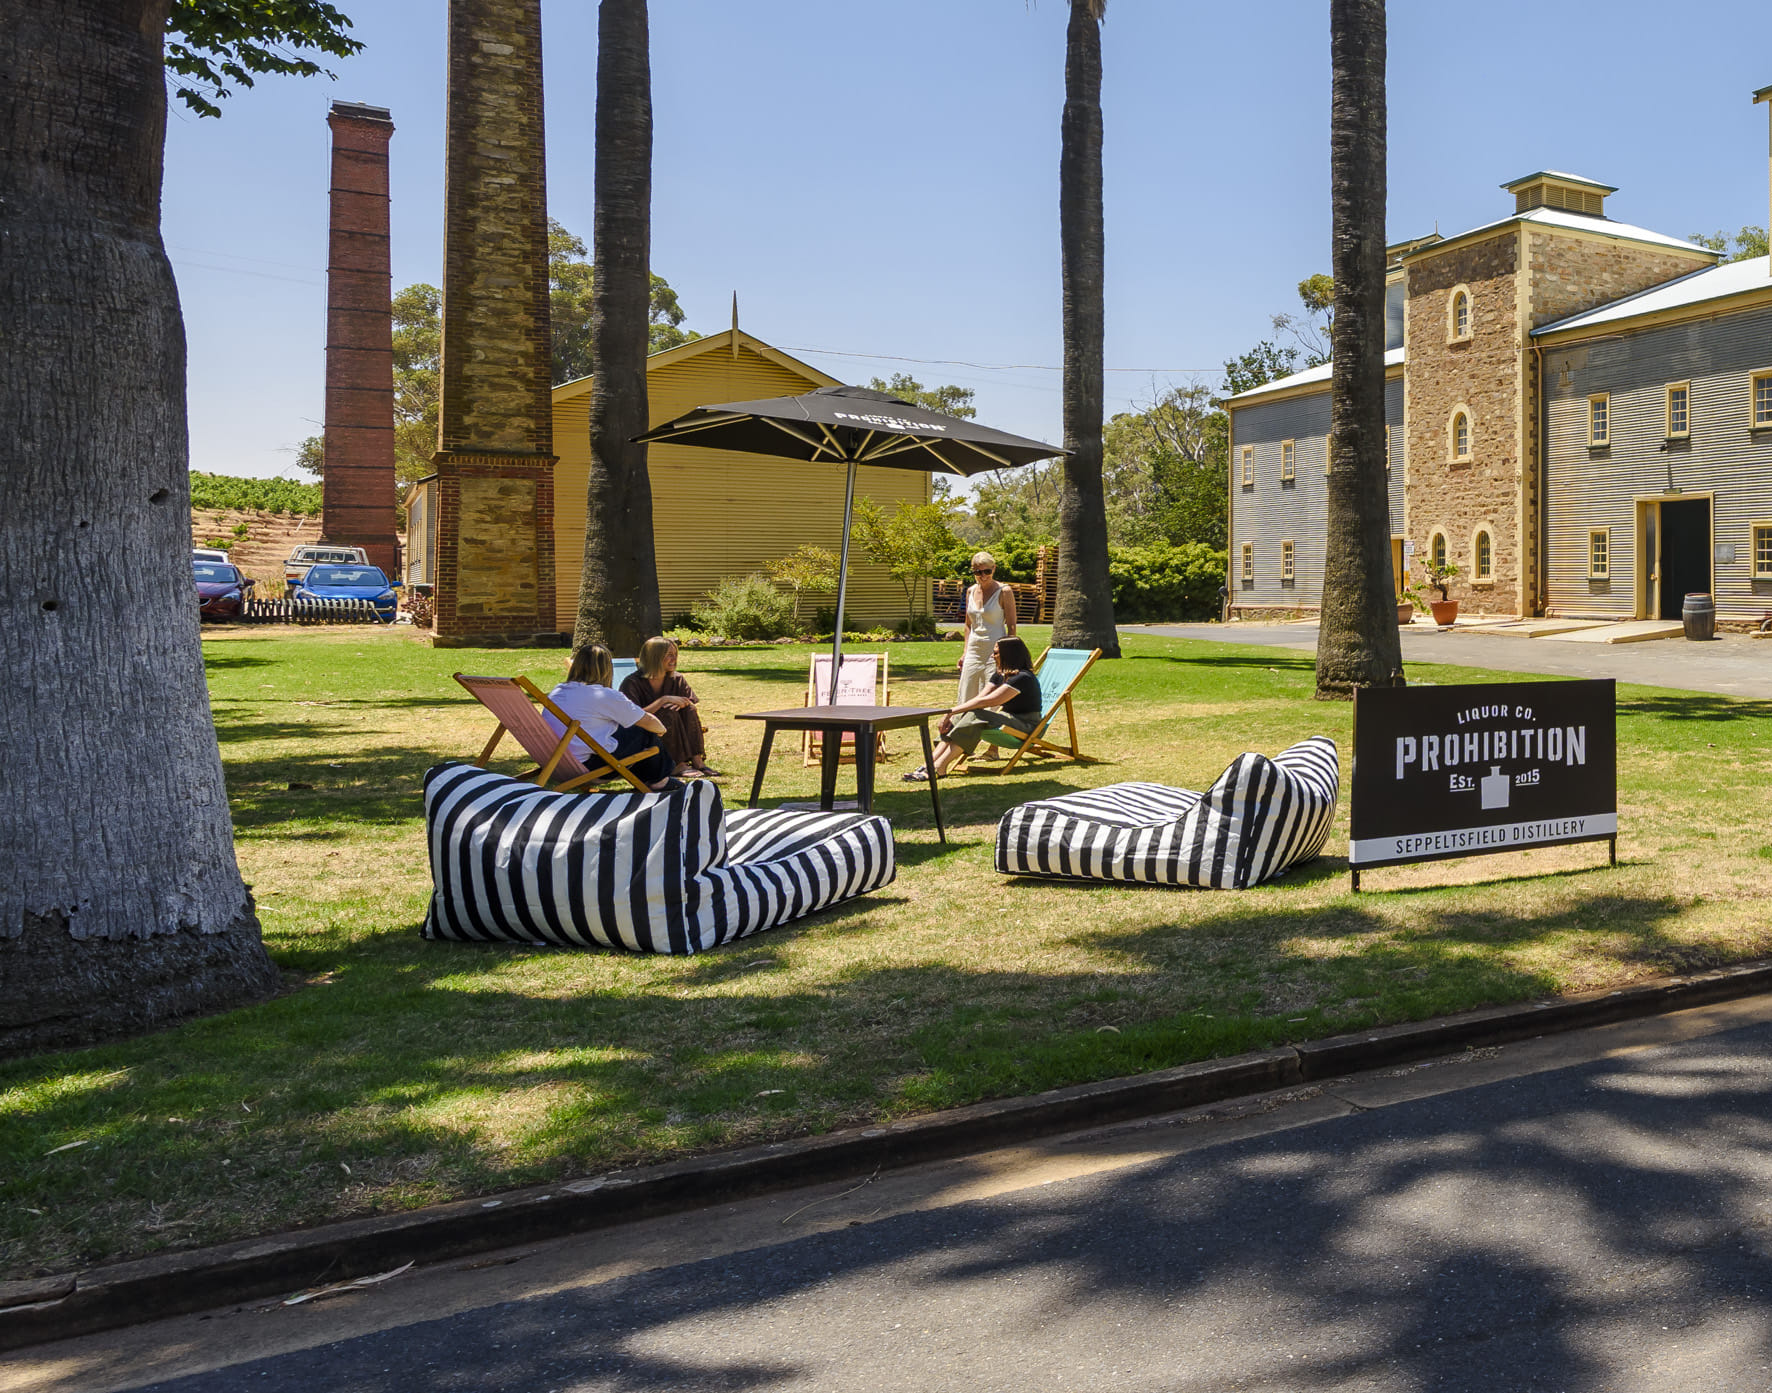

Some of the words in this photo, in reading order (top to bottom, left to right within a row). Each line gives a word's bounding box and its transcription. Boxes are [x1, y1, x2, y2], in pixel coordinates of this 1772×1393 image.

[1457, 704, 1508, 725] LIQUOR
[1515, 705, 1536, 722] CO.
[1396, 725, 1586, 780] PROHIBITION
[1515, 768, 1540, 784] 2015
[1396, 828, 1506, 855] SEPPELTSFIELD
[1512, 819, 1586, 841] DISTILLERY
